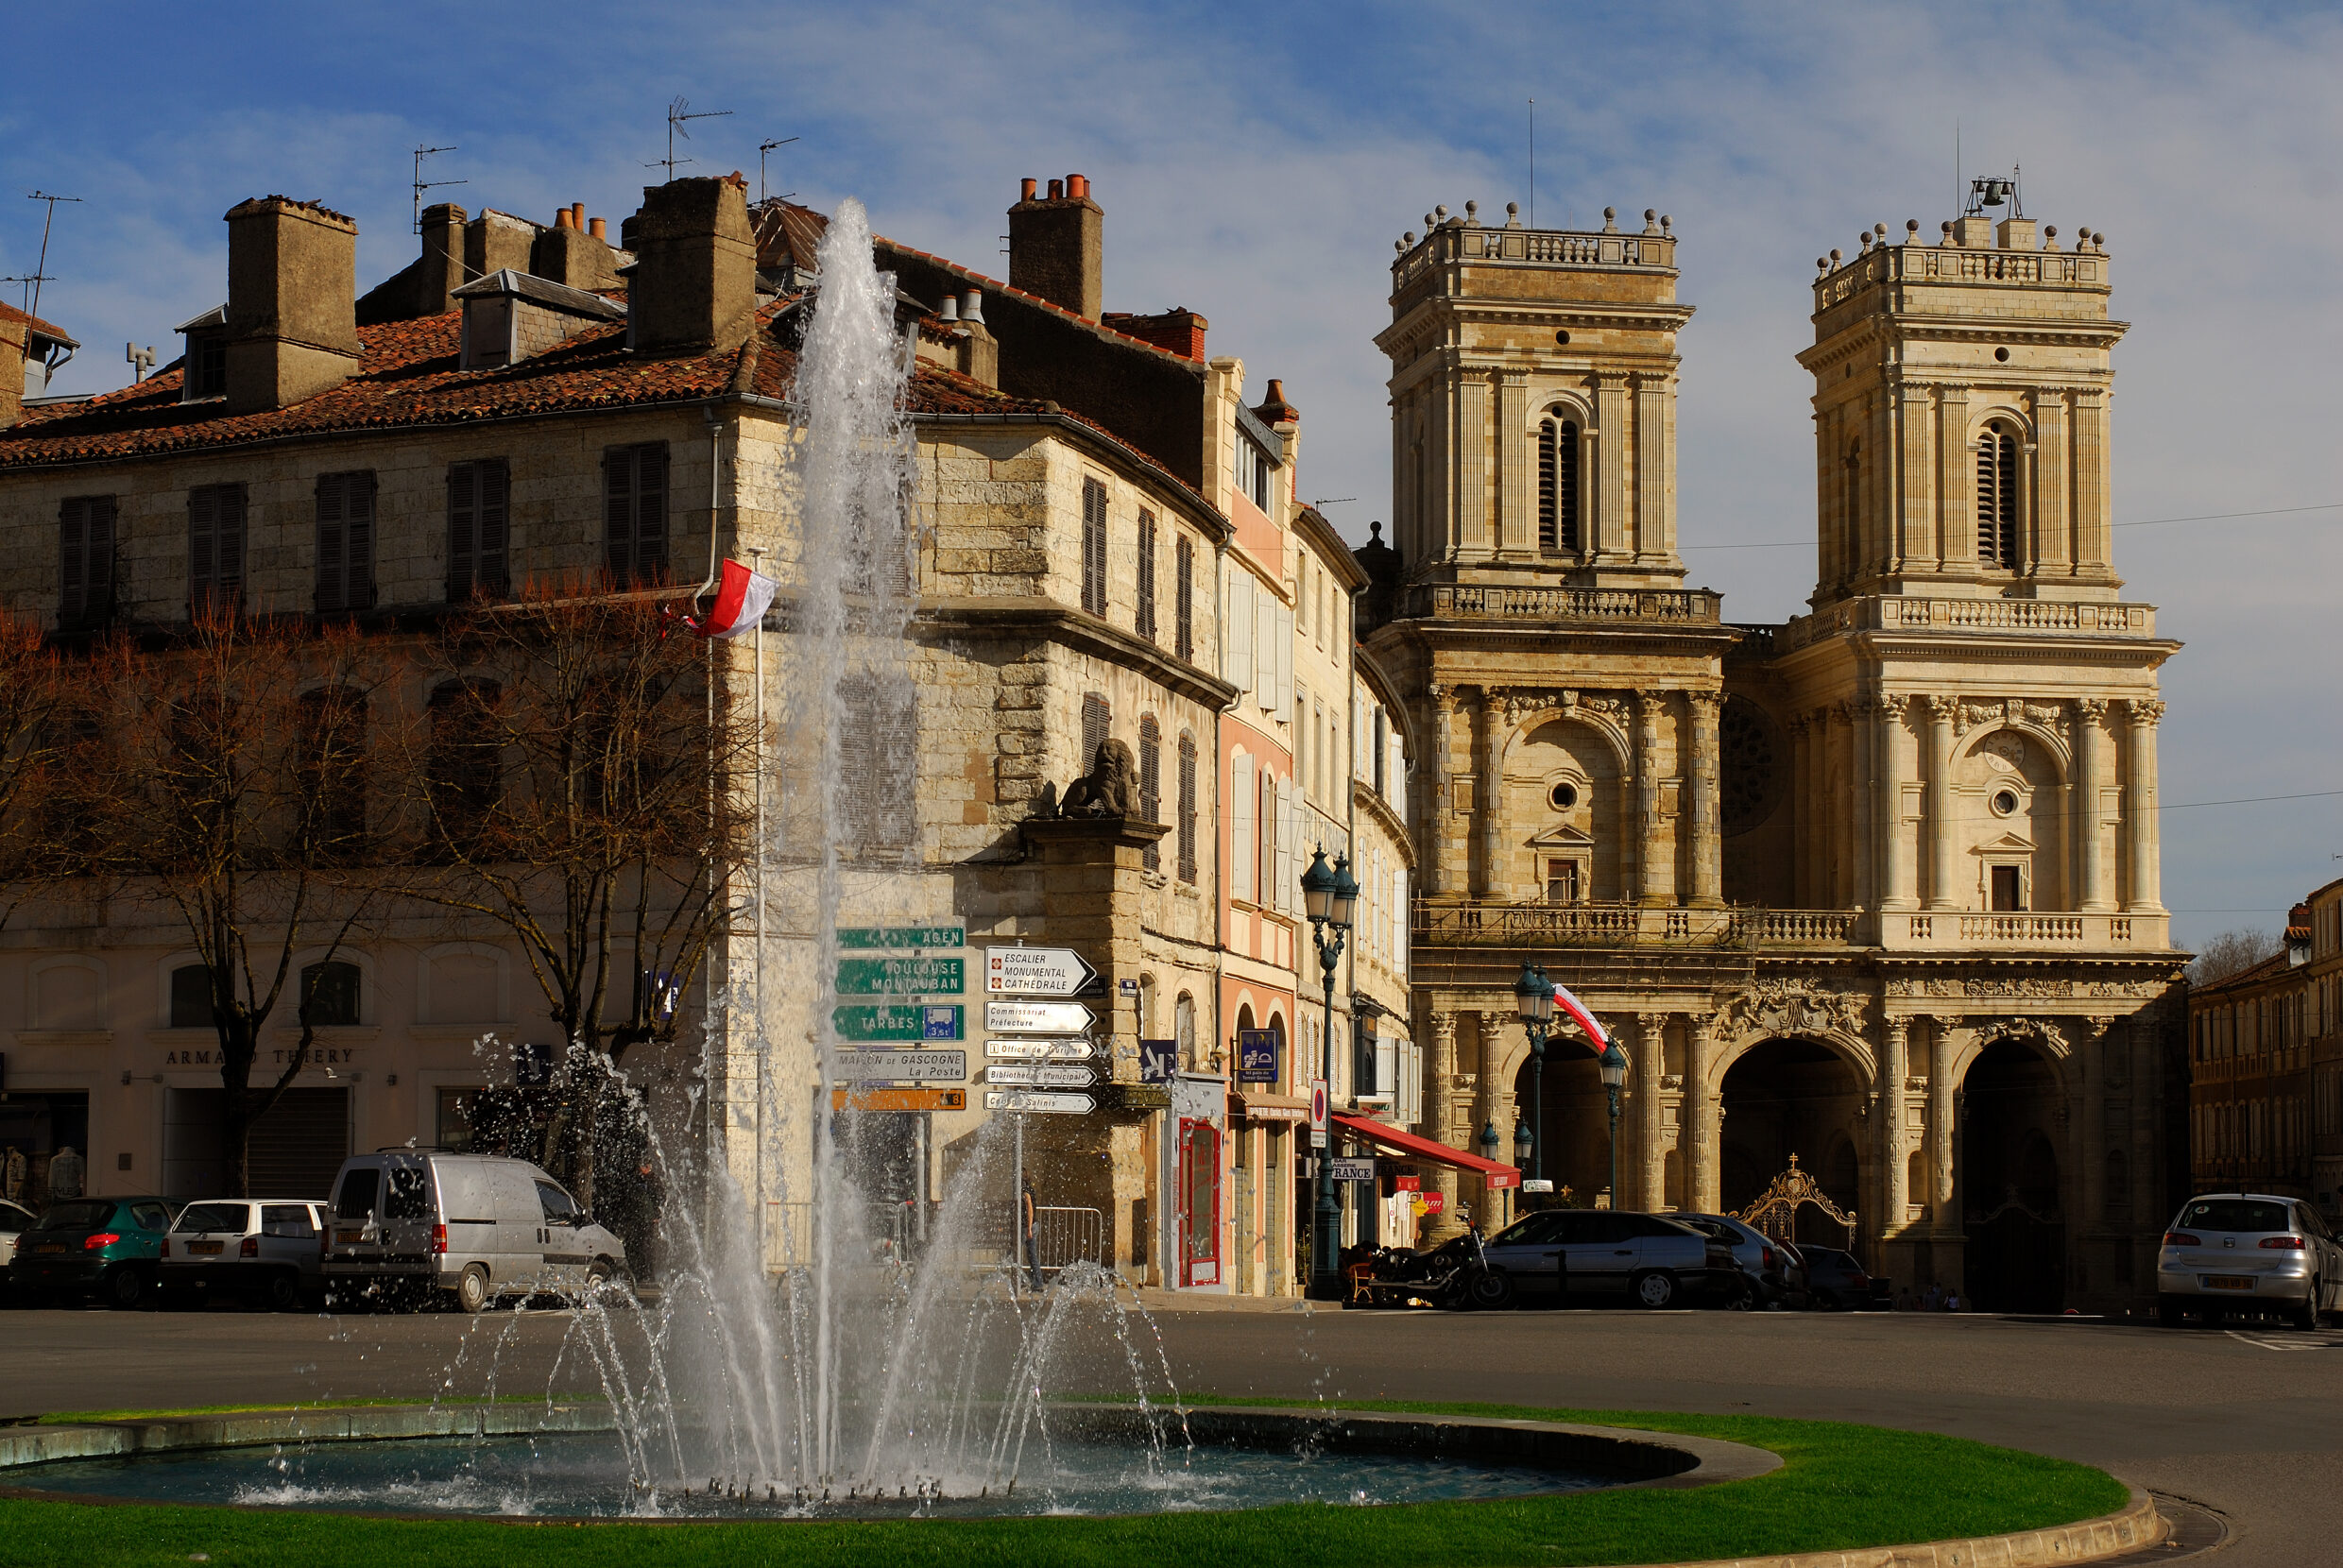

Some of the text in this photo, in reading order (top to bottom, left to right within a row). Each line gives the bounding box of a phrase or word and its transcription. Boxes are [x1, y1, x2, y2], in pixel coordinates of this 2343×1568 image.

[923, 931, 959, 943] AGEN
[1004, 953, 1046, 963] ESCALIER
[885, 963, 958, 974] OULUSE
[1004, 966, 1067, 978] MONUMENTAL
[872, 979, 958, 990] MONTAUBAN
[1004, 978, 1068, 990] CATHÉDRALE
[990, 1007, 1046, 1016] Commissariat
[862, 1017, 915, 1029] TARBES
[990, 1017, 1034, 1027] Préfecture
[1001, 1045, 1026, 1053] Office
[1048, 1046, 1083, 1054] Tourie
[166, 1048, 353, 1065] ARMA THIERY
[838, 1055, 882, 1065] MAION
[901, 1055, 962, 1065] GASCOGNE
[909, 1066, 962, 1076] La Poste
[991, 1070, 1086, 1081] Bibliothè Municipale
[1027, 1098, 1055, 1107] Salinis
[1332, 1167, 1371, 1178] RANCE
